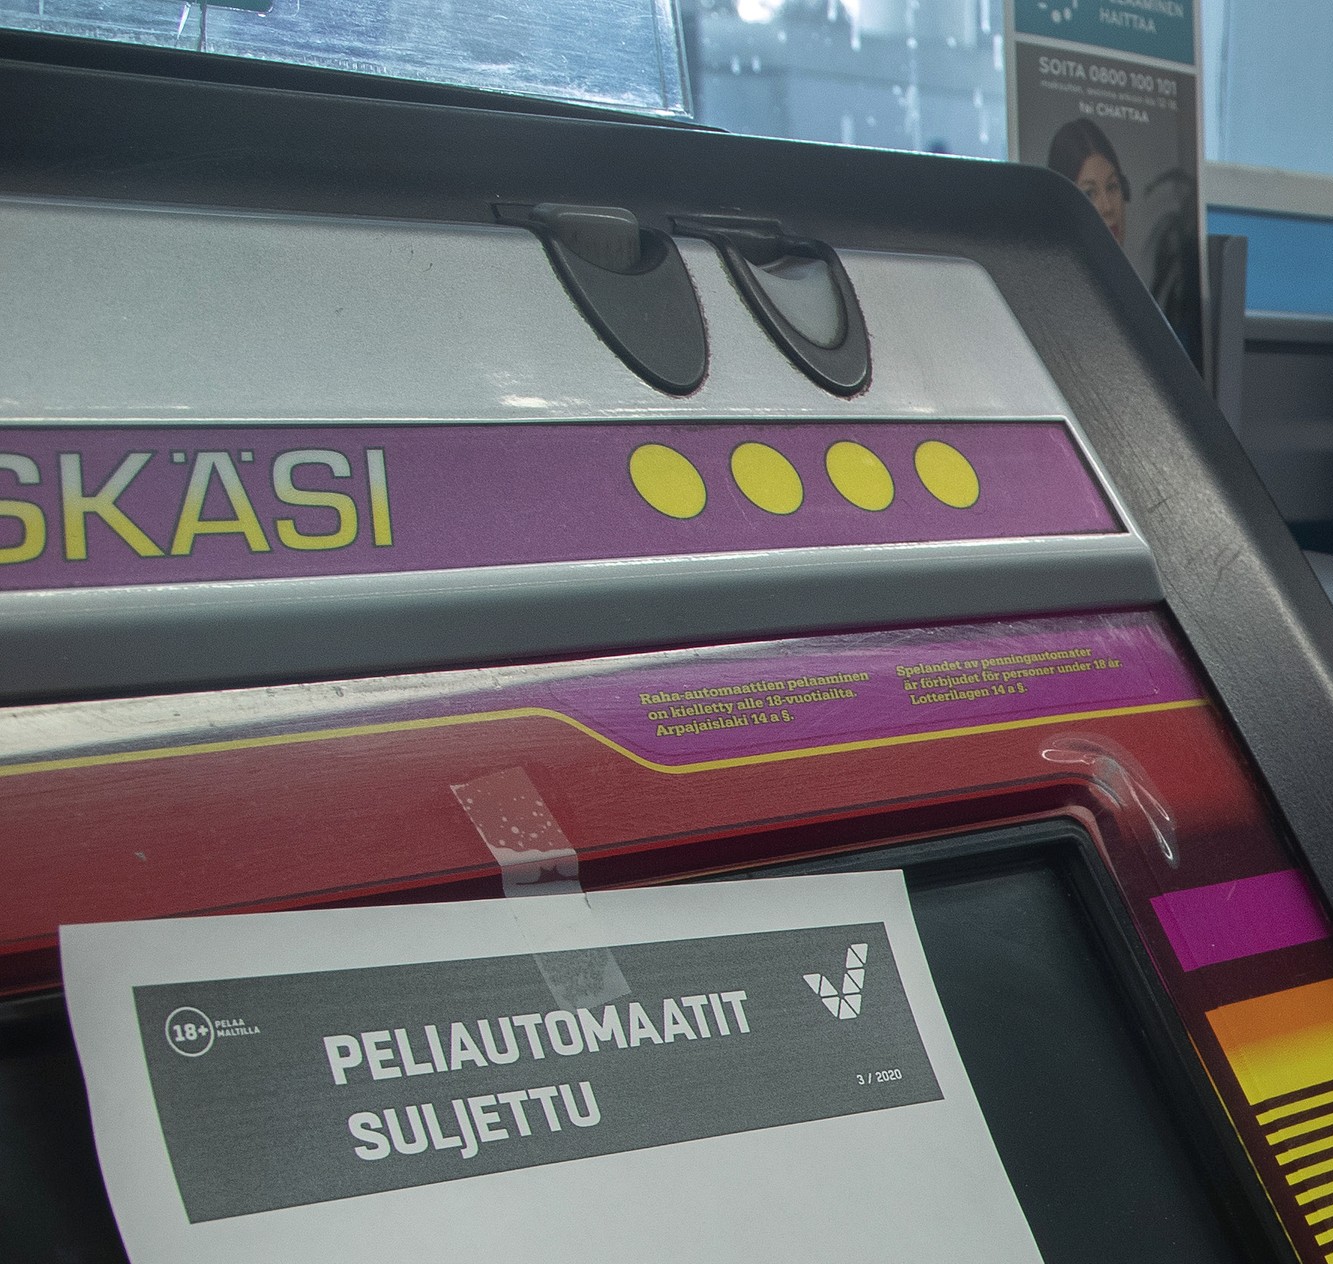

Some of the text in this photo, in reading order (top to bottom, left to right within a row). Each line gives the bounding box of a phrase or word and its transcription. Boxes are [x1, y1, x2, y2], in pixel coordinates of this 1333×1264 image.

[1038, 56, 1087, 80] SOITA
[1089, 64, 1127, 88] 0800
[1096, 102, 1150, 124] CHATTAA
[896, 647, 1093, 677] Spelandet av penningautomater
[904, 657, 1123, 691] är förbjudet för personer under 18 år.
[639, 671, 870, 706] Raha-automaattien pelaaminen
[910, 682, 1028, 706] Lotterilagen 14 a §.
[647, 688, 858, 721] on kielletty alle 18-vuotiailta.
[656, 709, 795, 737] Arpajaislaki 14 a §.
[173, 1023, 261, 1042] 18+ MALTILLA
[215, 1018, 245, 1028] PELAA
[323, 990, 751, 1086] PELIAUTOMAATIT
[875, 1068, 903, 1082] 2020
[348, 1081, 601, 1161] SULJETTU
